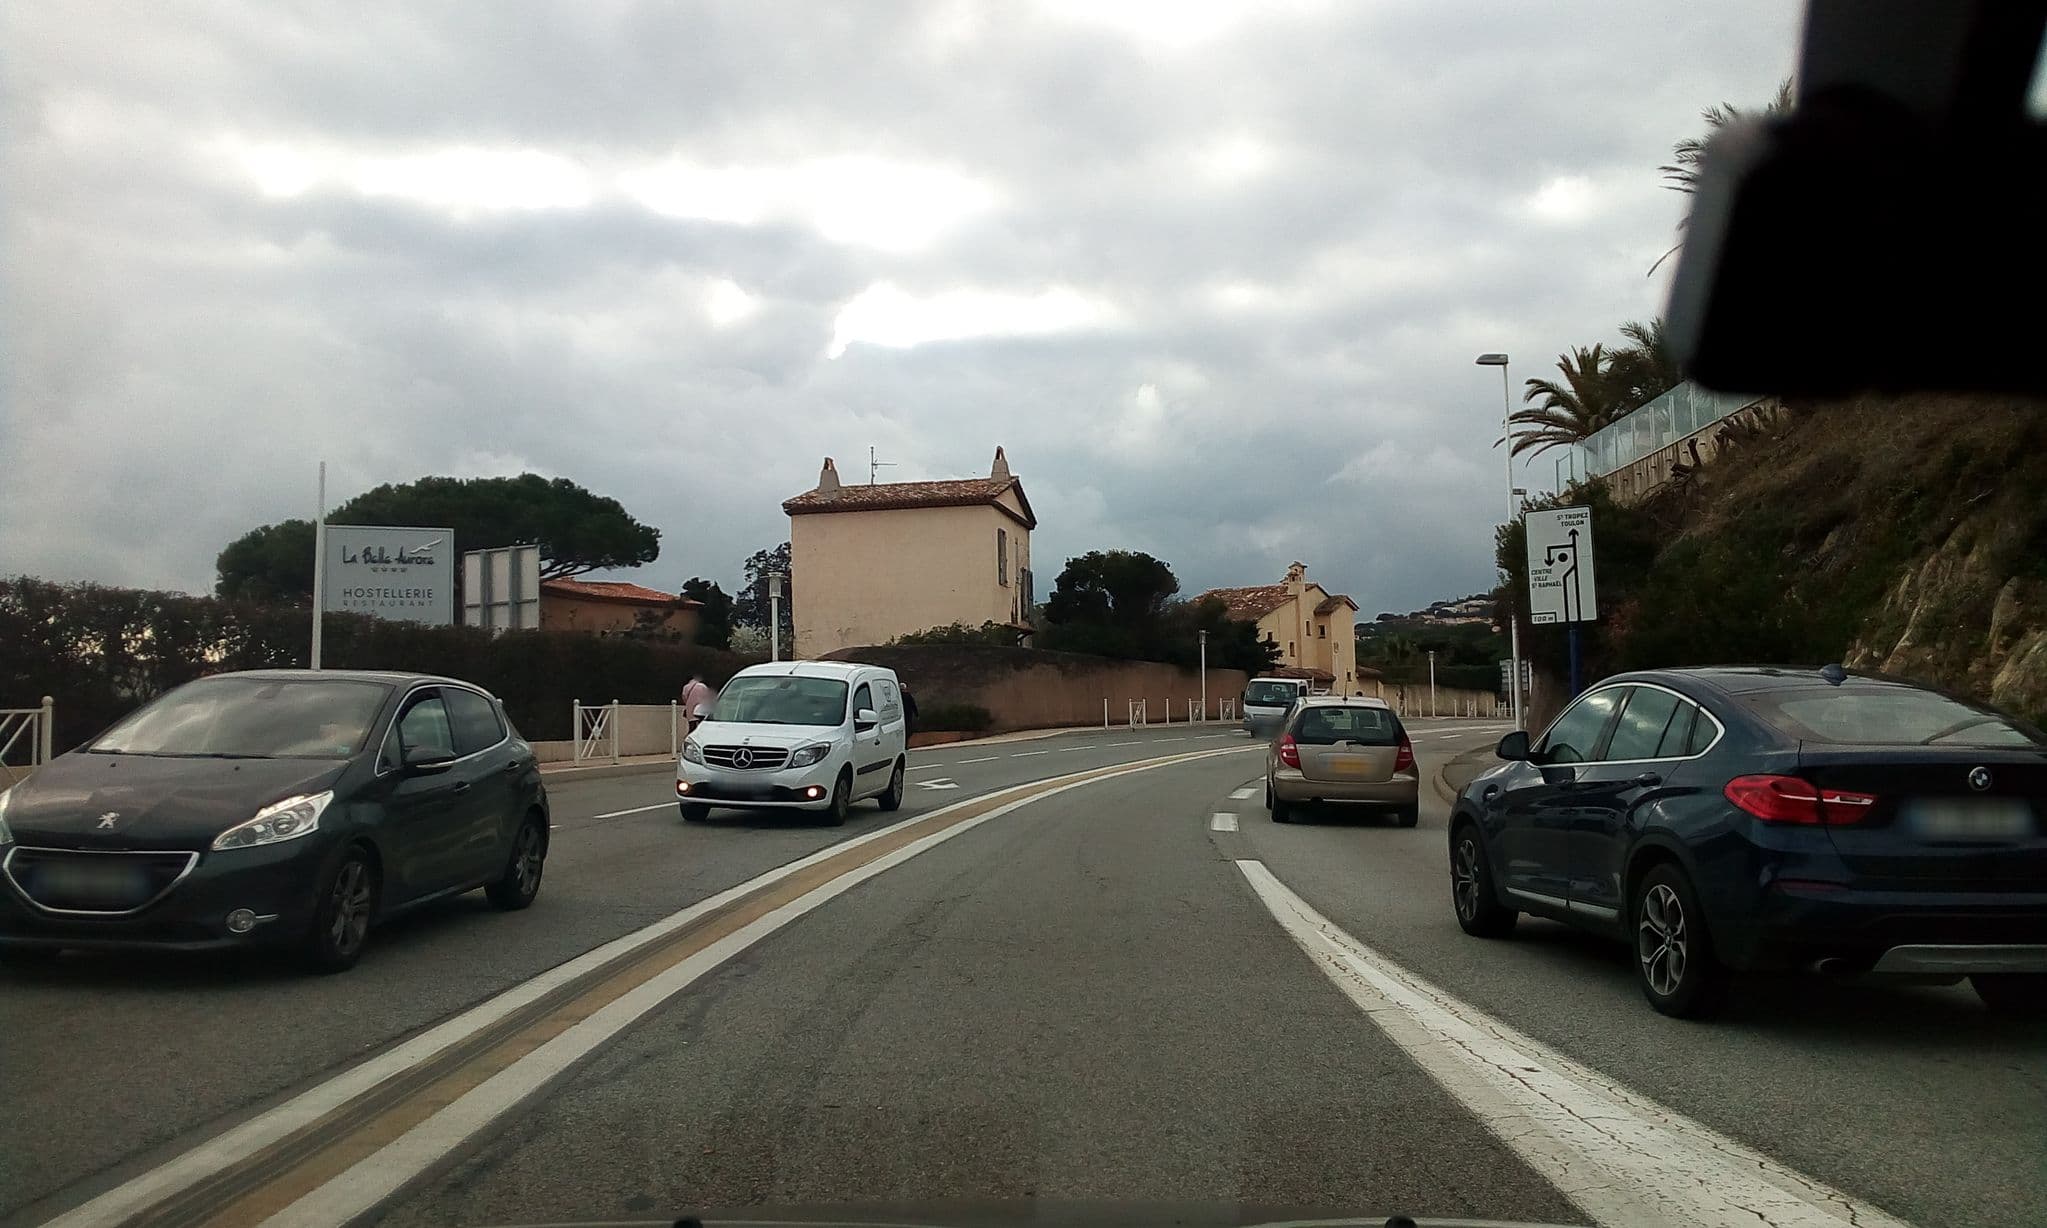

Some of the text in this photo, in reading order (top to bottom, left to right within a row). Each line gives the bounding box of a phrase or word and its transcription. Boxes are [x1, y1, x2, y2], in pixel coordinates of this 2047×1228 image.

[342, 545, 357, 563] La
[362, 546, 391, 564] Belle
[343, 587, 433, 598] HOSTELLERIE
